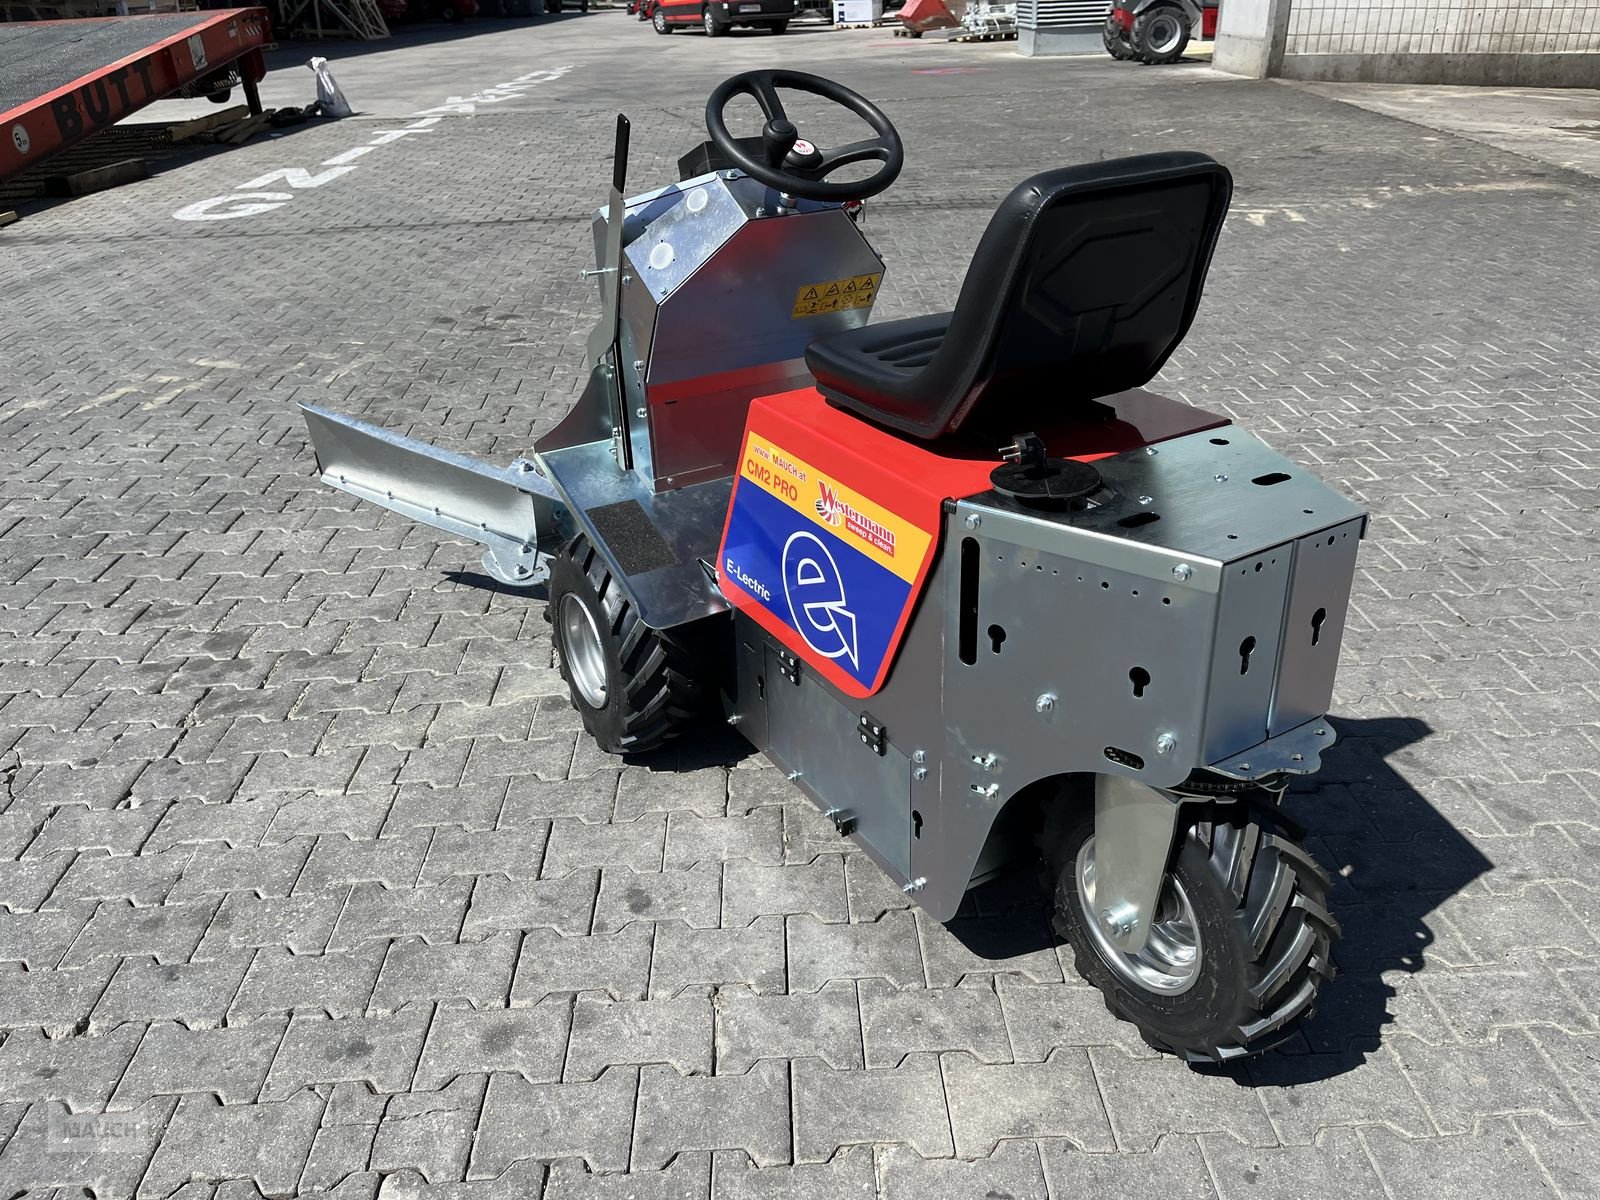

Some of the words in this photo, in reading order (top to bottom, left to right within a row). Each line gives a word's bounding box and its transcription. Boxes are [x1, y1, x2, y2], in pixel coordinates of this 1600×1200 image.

[51, 57, 154, 142] BUTT
[747, 459, 771, 486] CM2
[773, 475, 798, 502] PRO
[818, 480, 896, 545] Westermann
[847, 521, 867, 538] sweep
[867, 533, 873, 542] &
[726, 558, 771, 602] E-Lectric
